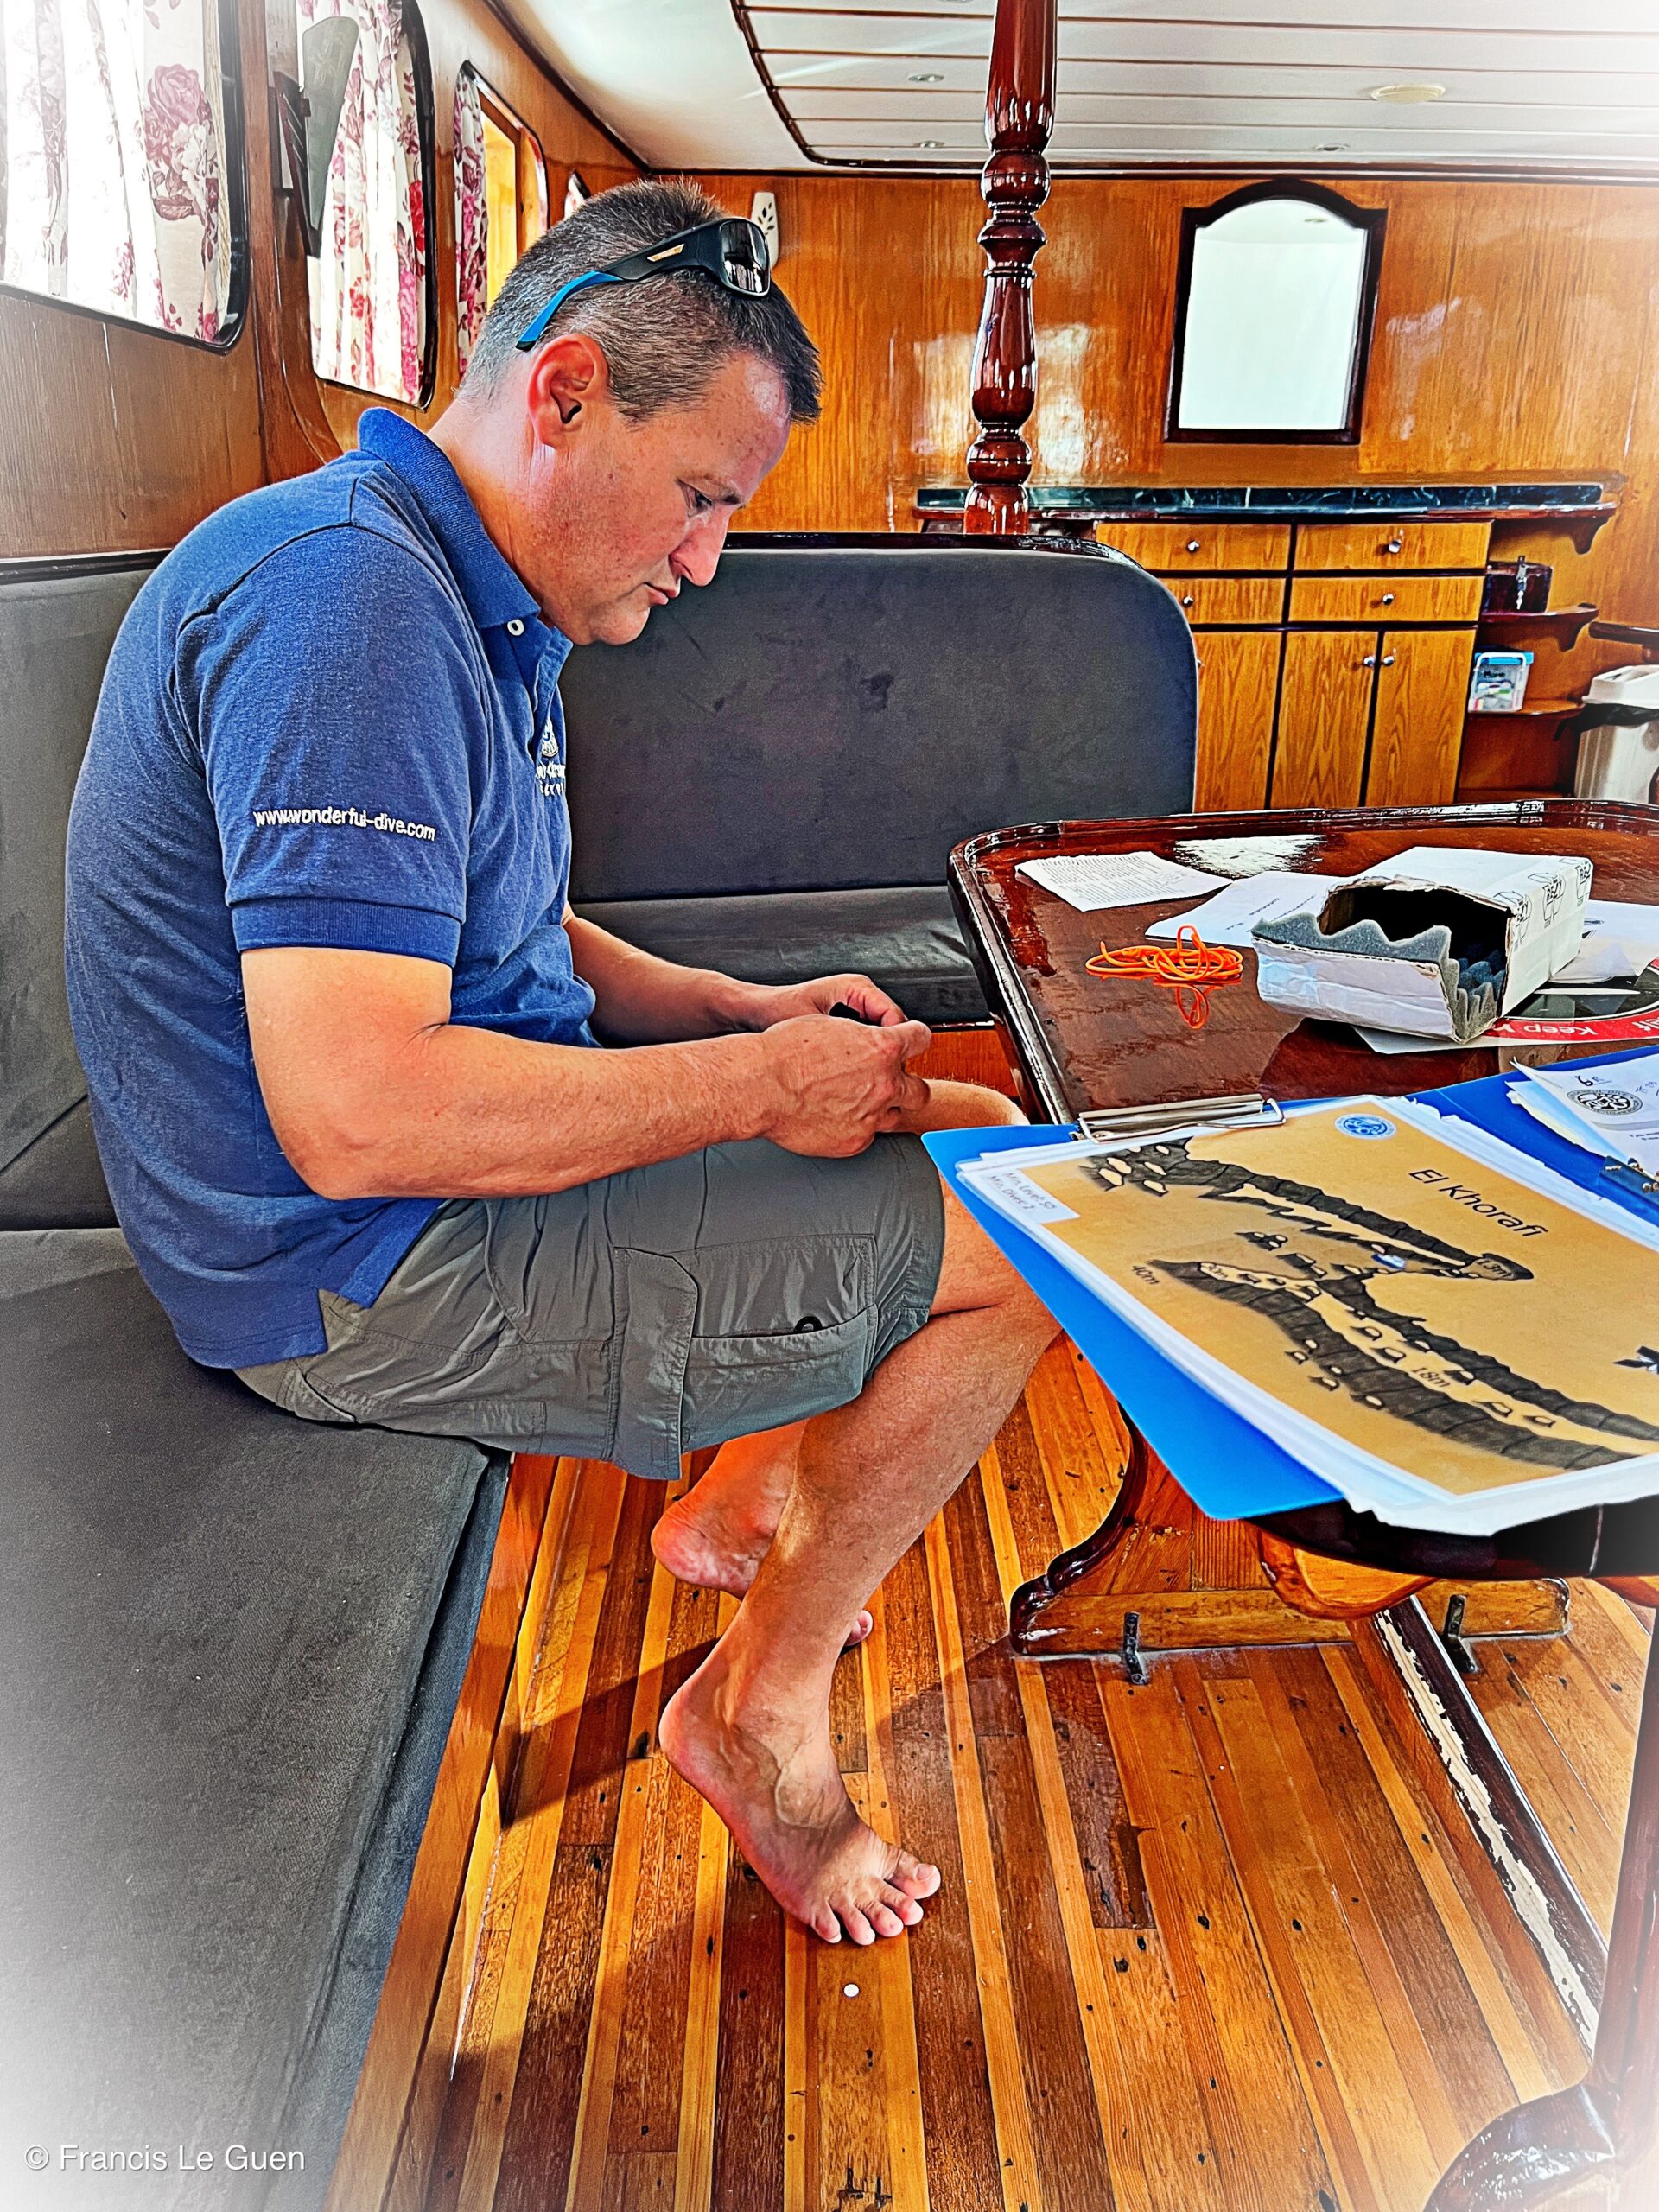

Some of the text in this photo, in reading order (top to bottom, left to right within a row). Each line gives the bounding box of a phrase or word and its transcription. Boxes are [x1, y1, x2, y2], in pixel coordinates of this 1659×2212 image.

[1523, 1023, 1598, 1036] Keep
[1408, 1169, 1549, 1237] El Khorafi
[1132, 1265, 1160, 1285] 40m
